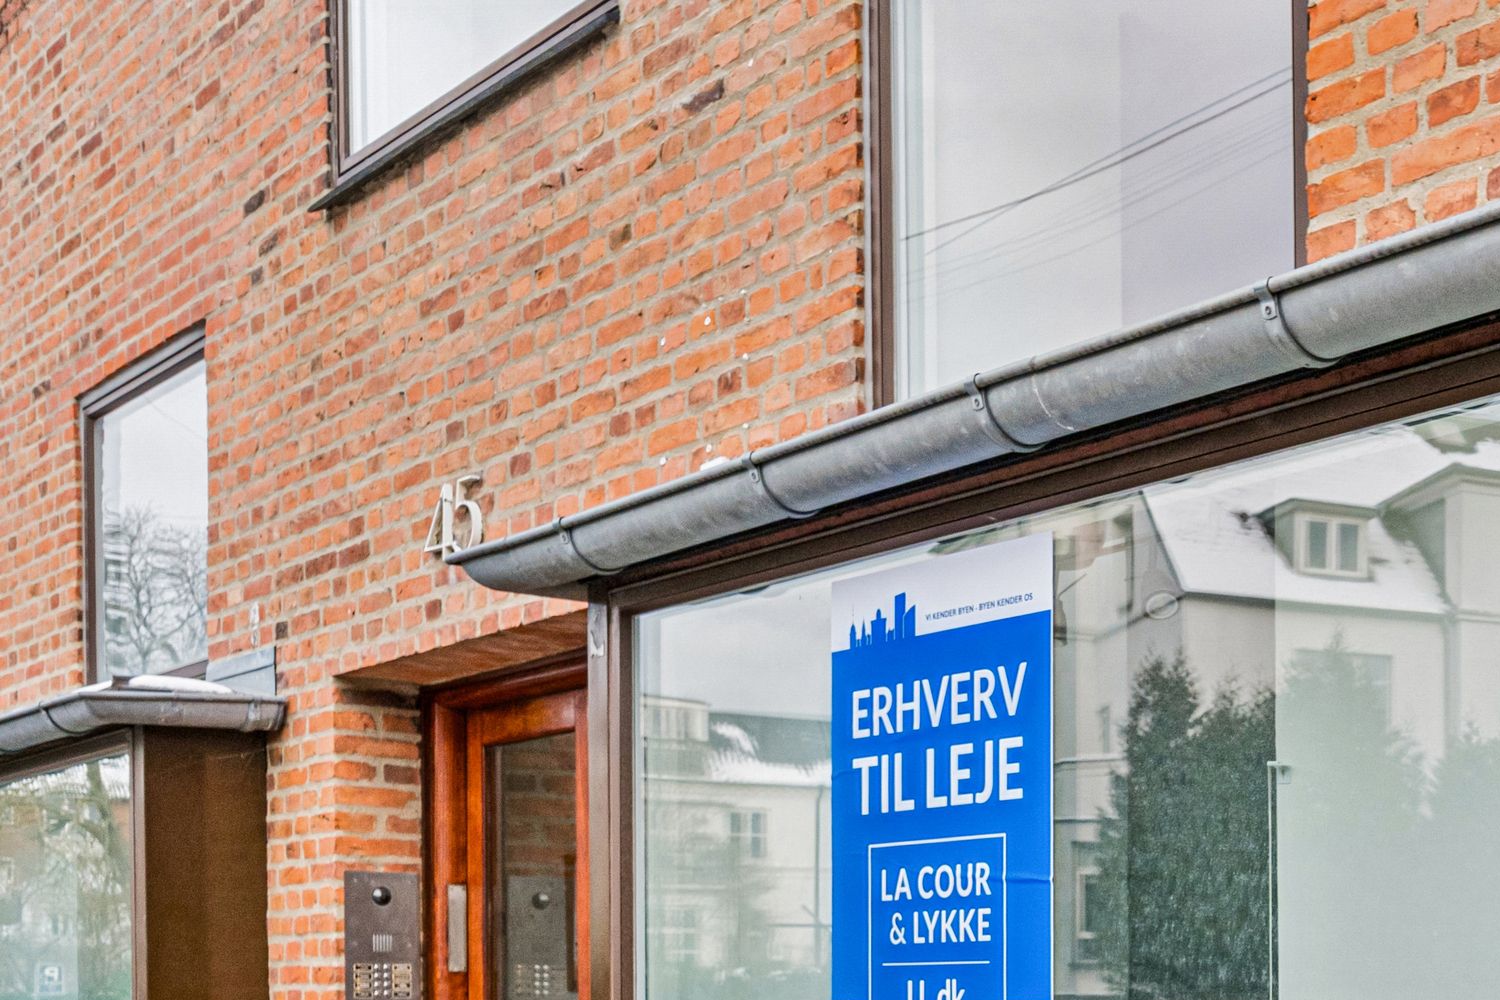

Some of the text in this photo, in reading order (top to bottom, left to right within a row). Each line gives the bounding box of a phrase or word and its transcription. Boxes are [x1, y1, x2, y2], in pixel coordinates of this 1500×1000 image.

[423, 475, 482, 561] 45
[932, 608, 957, 620] KENDER
[958, 604, 974, 615] BYEN
[979, 600, 996, 611] BYEN
[997, 594, 1023, 607] KENDER
[1024, 592, 1033, 602] OS
[852, 661, 1028, 739] ERHVERV
[852, 736, 1024, 816] TIL LEJE
[881, 862, 992, 902] LA COUR
[889, 907, 992, 945] & LYKKE
